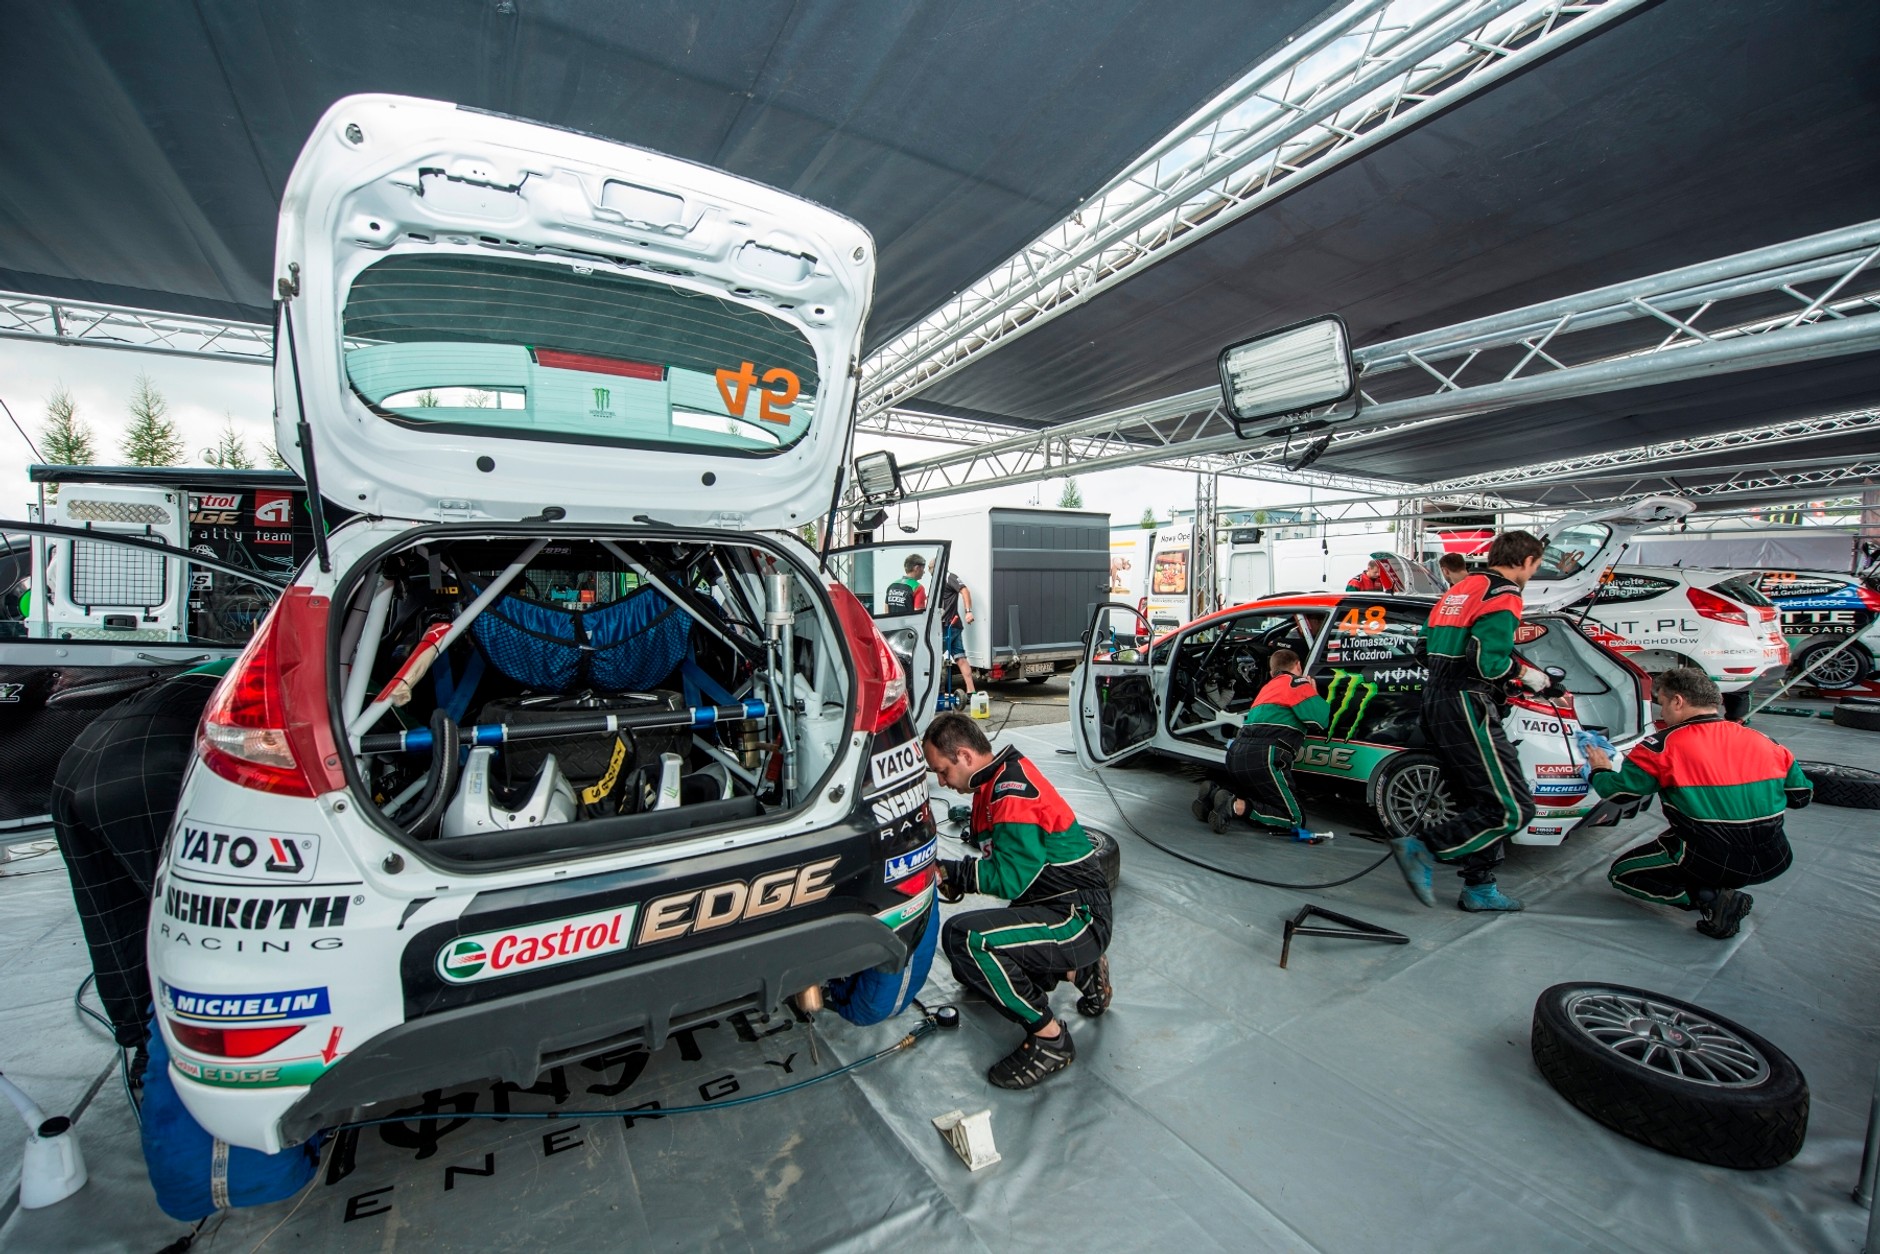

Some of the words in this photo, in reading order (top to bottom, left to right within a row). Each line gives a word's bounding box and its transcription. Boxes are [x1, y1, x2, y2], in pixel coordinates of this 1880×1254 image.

[200, 494, 235, 508] strol
[256, 531, 291, 541] team
[1338, 605, 1387, 636] 48
[1810, 626, 1856, 634] CARS
[1341, 636, 1405, 649] J.Tomaszczyk
[1342, 651, 1352, 661] K.
[1522, 720, 1560, 733] YATO
[876, 747, 914, 779] YATO
[181, 827, 258, 868] YATO
[164, 884, 351, 930] SCHROTH
[489, 914, 621, 970] Castrol
[638, 855, 842, 946] EDGE
[160, 922, 344, 953] RACING
[176, 993, 318, 1017] MICHELIN
[203, 1067, 281, 1083] EDGE
[343, 1052, 798, 1224] ENERGY
